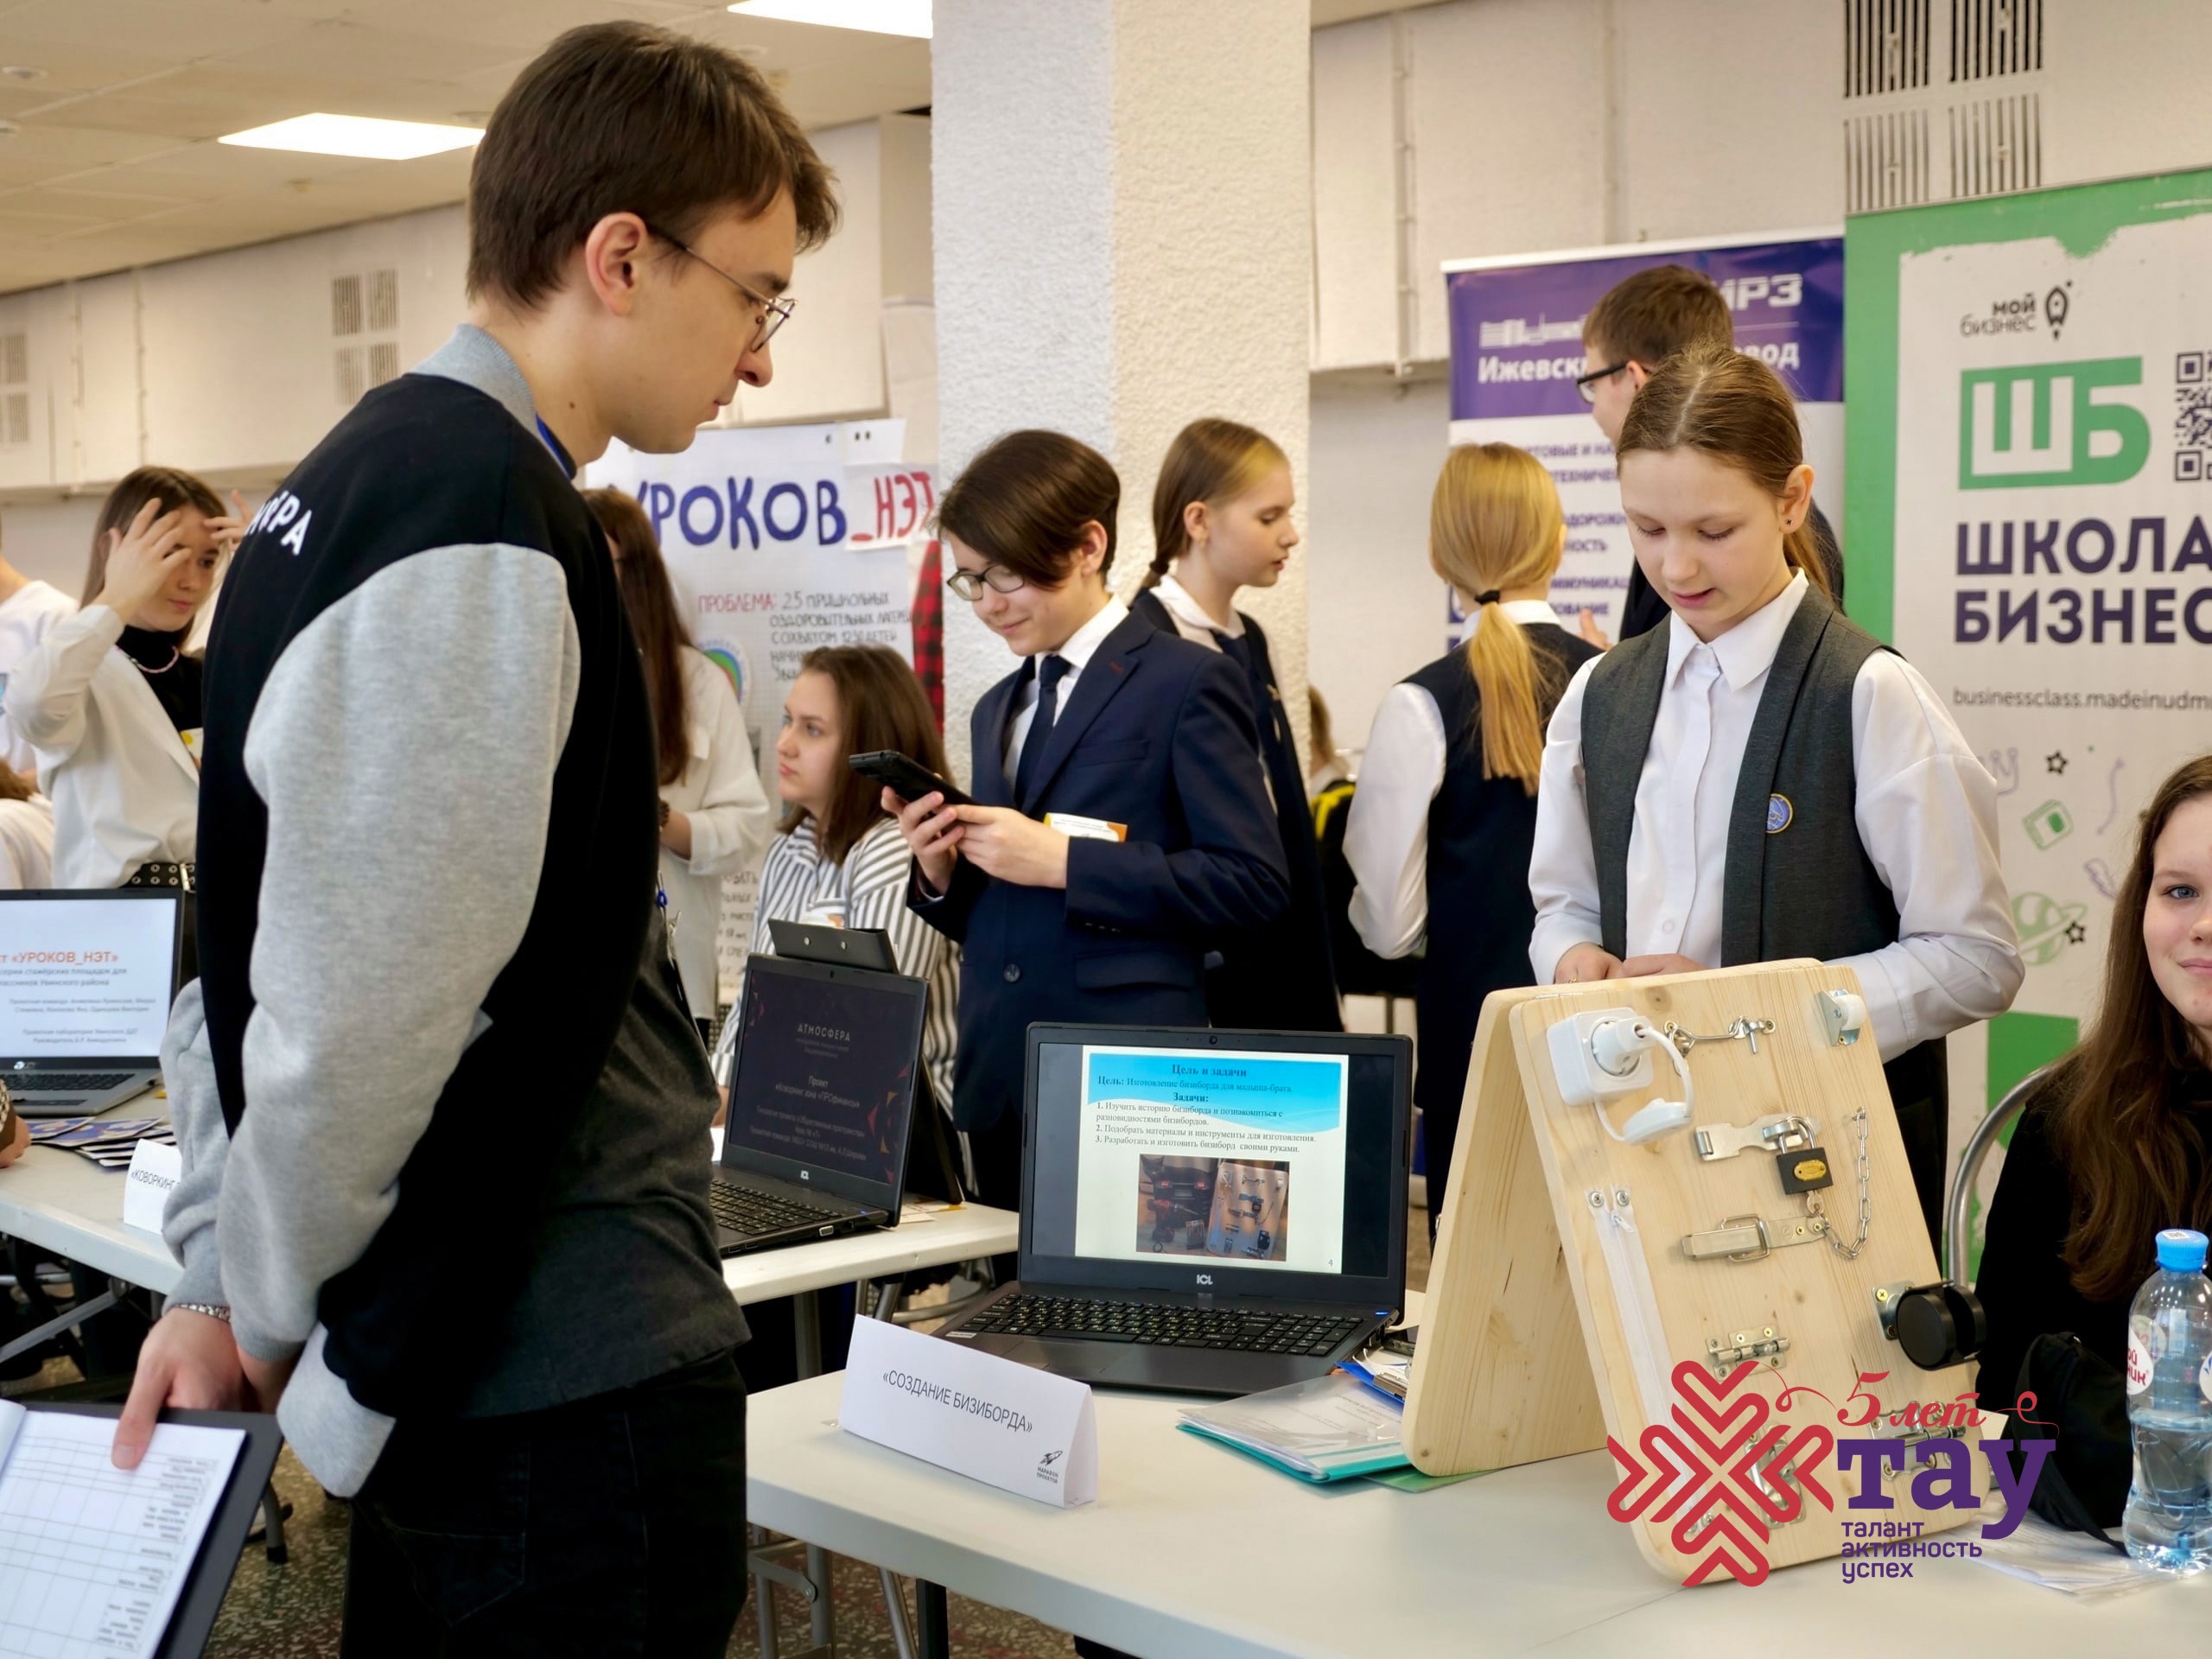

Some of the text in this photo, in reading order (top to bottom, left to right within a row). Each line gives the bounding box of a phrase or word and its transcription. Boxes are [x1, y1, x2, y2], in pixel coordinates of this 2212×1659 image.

[1993, 292, 2036, 315] мой
[1960, 313, 2037, 338] бизнес
[1478, 355, 1587, 384] Ижевск
[1959, 355, 2152, 490] ШБ
[1955, 515, 2212, 576] ШКОЛА
[12, 950, 119, 966] «УРОКОВ_НЭТ»
[797, 1023, 850, 1042] АТМОСФЕРА
[1172, 1064, 1198, 1076] Цель
[1211, 1068, 1247, 1077] задачи
[1097, 1076, 1124, 1086] Цель:
[1127, 1077, 1178, 1088] Изготовление
[1179, 1079, 1219, 1090] бизиборда
[1173, 1091, 1209, 1103] Задачи:
[1096, 1114, 1161, 1122] разновидностями
[1106, 1102, 1136, 1112] Изучить
[1138, 1104, 1171, 1114] историю
[1172, 1104, 1211, 1116] бизиборда
[1220, 1109, 1277, 1117] познакомиться
[1104, 1124, 1144, 1135] Подобрать
[1146, 1128, 1186, 1137] материалы
[1195, 1131, 1245, 1141] инструменты
[1095, 1135, 1102, 1143] 3.
[1104, 1135, 1148, 1146] Разработать
[1200, 1141, 1236, 1151] бизиборд
[1269, 1145, 1300, 1154] руками.
[1196, 1274, 1213, 1285] ICL
[882, 1370, 1033, 1433] «СОЗДАНИЕ БИЗИБОРДА»
